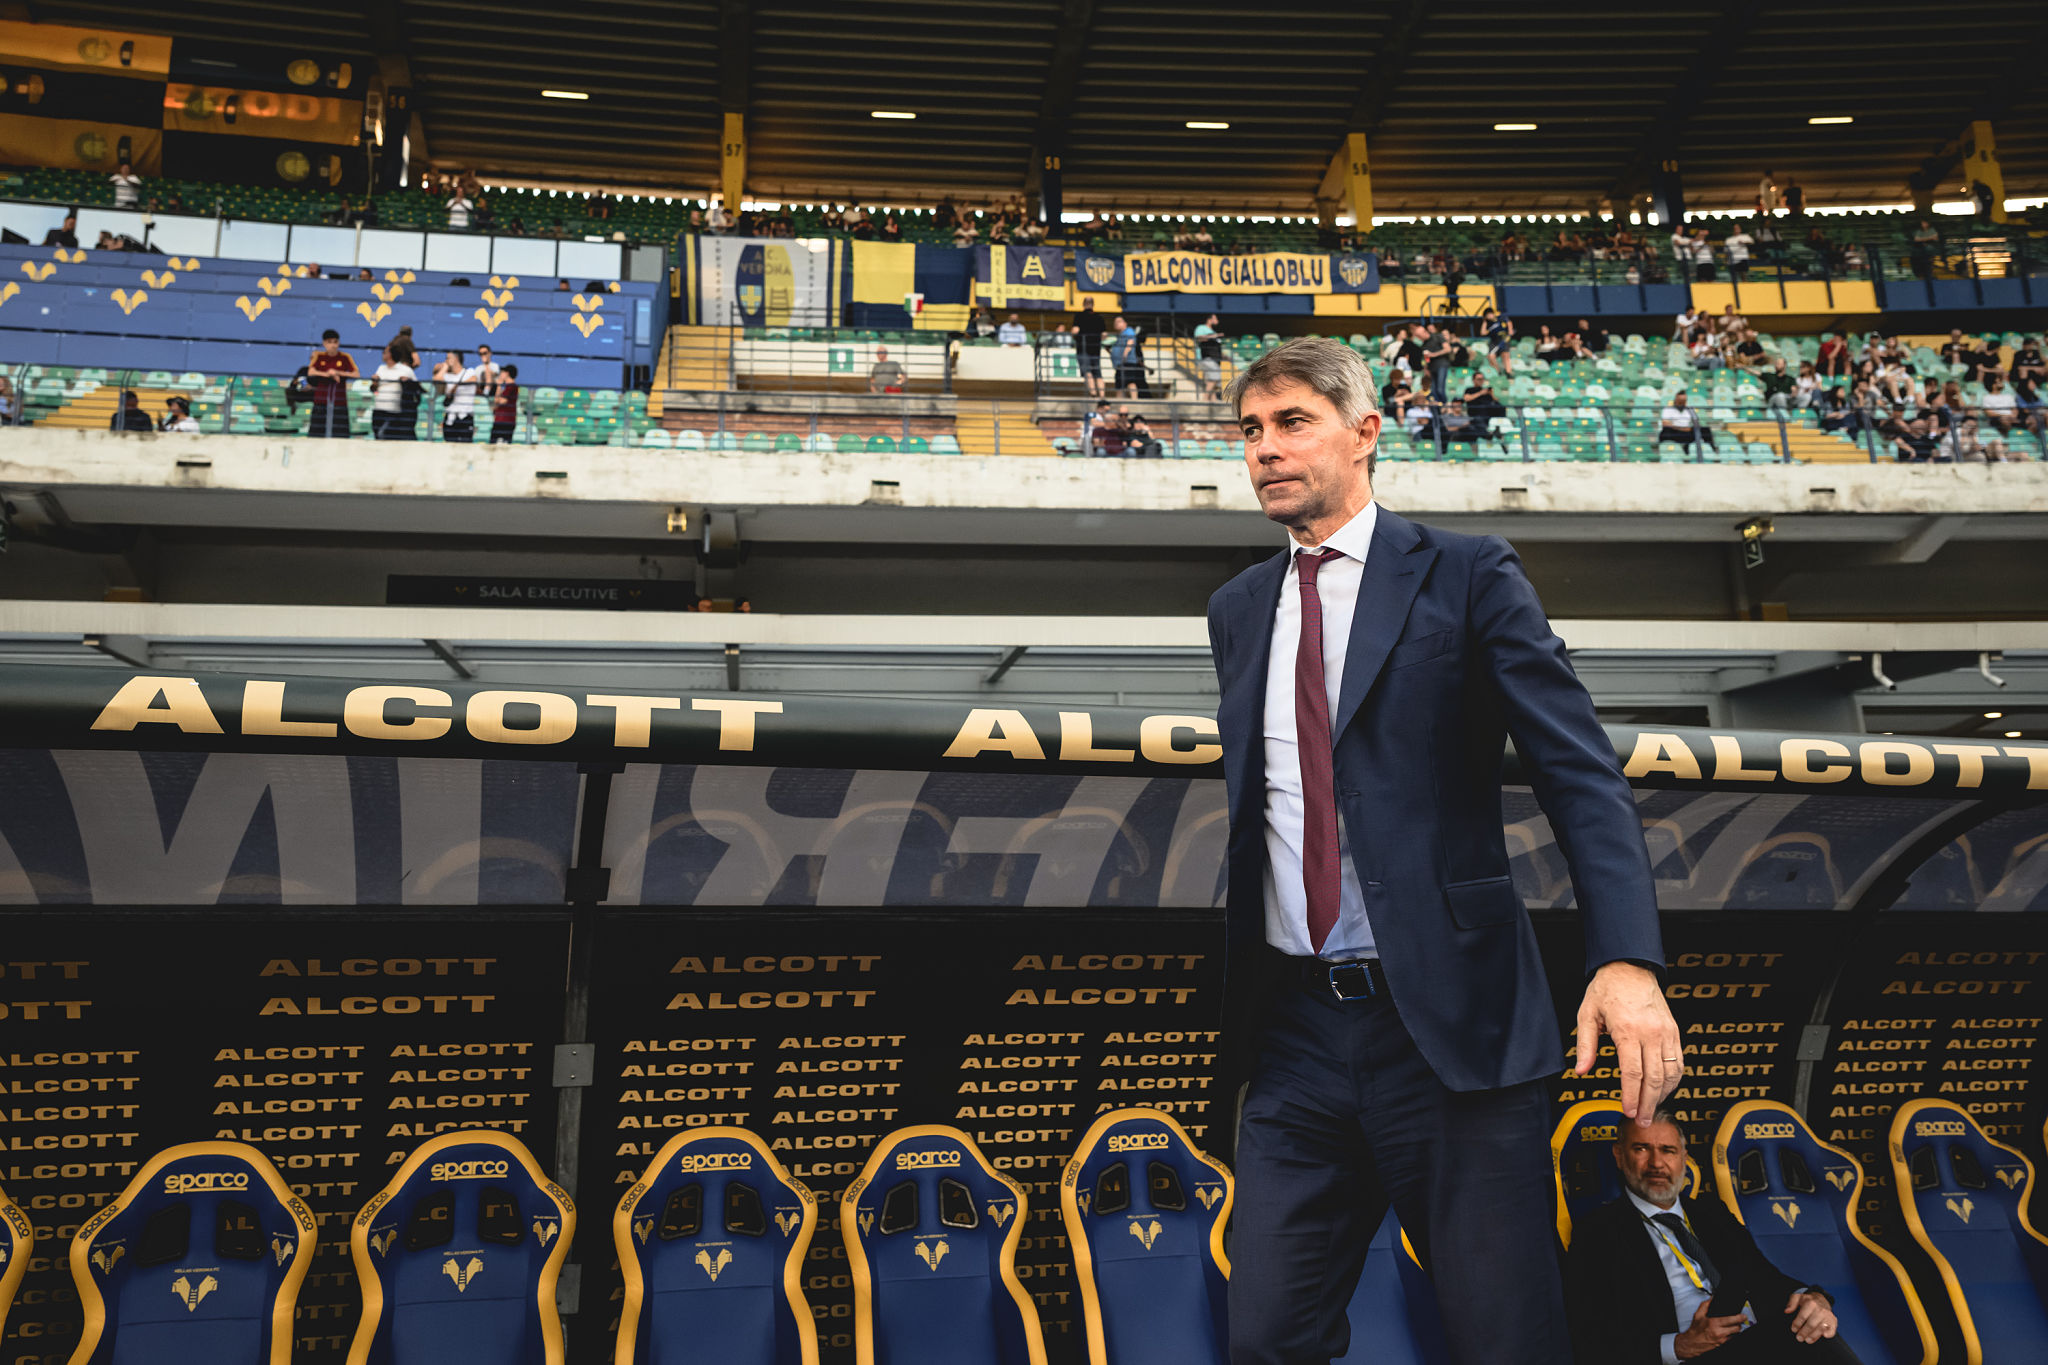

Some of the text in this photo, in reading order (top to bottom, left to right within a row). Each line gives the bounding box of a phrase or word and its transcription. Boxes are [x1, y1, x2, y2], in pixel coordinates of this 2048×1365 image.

[726, 143, 742, 157] 57
[740, 263, 792, 276] VERONA
[1131, 257, 1213, 287] BALCONI
[1220, 257, 1324, 286] GIALLOBLU
[479, 585, 619, 600] SALA EXECUTIVE
[90, 675, 783, 751] ALCOTT
[942, 708, 1224, 765] ALC
[1623, 733, 2048, 790] ALCOTT
[670, 956, 881, 973] ALCOTT
[1012, 955, 1205, 970] ALCOTT
[1666, 953, 1784, 968] COTT
[1896, 952, 2047, 965] ALCOTT
[260, 959, 496, 976] ALCOTT
[1665, 984, 1771, 999] COTT
[1882, 981, 2031, 994] ALCOTT
[666, 991, 876, 1009] ALCOTT
[1005, 989, 1196, 1005] ALCOTT
[259, 996, 495, 1015] ALCOTT
[1686, 1023, 1784, 1034] ALCOTT
[1843, 1019, 1936, 1030] ALCOTT
[1952, 1019, 2042, 1028] ALCOTT
[779, 1036, 906, 1048] ALCOTT
[963, 1033, 1084, 1045] ALCOTT
[1104, 1032, 1220, 1043] ALCOTT
[1946, 1038, 2036, 1049] ALCOTT
[390, 1043, 533, 1057] ALCOTT
[623, 1039, 756, 1052] ALCOTT
[1683, 1043, 1779, 1055] ALCOTT
[1838, 1040, 1931, 1051] ALCOTT
[214, 1046, 364, 1061] ALCOTT
[1101, 1054, 1216, 1066] ALCOTT
[621, 1063, 754, 1077] ALCOTT
[776, 1059, 903, 1073] ALCOTT
[960, 1056, 1080, 1069] ALCOTT
[1834, 1061, 1927, 1072] ALCOTT
[1942, 1059, 2032, 1070] ALCOTT
[214, 1072, 363, 1087] ALCOTT
[389, 1068, 531, 1083] ALCOTT
[774, 1084, 900, 1098] ALCOTT
[958, 1080, 1078, 1093] ALCOTT
[1098, 1077, 1213, 1090] ALCOTT
[1832, 1082, 1924, 1095] ALCOTT
[1939, 1080, 2028, 1092] ALCOTT
[619, 1087, 751, 1102] ALCOTT
[1674, 1086, 1771, 1099] ALCOTT
[213, 1098, 362, 1114] ALCOTT
[388, 1094, 530, 1109] ALCOTT
[1967, 1102, 2026, 1114] COTT
[772, 1109, 898, 1123] ALCOTT
[956, 1104, 1075, 1118] ALCOTT
[1829, 1105, 1892, 1118] ALCO
[617, 1112, 750, 1129] ALCOTT
[967, 1129, 1073, 1144] LCOTT
[1580, 1125, 1618, 1142] spar
[1744, 1123, 1795, 1140] sparco
[772, 1134, 881, 1150] ALCOT
[1108, 1133, 1169, 1152] sparco
[681, 1153, 752, 1173] sparco
[896, 1150, 961, 1170] sparco
[993, 1155, 1071, 1169] COTT
[431, 1160, 508, 1181] sparco
[164, 1172, 249, 1193] sparco
[545, 1183, 574, 1213] sparco
[620, 1182, 646, 1213] sparco
[287, 1197, 314, 1232] sparco
[357, 1191, 388, 1227] sparco
[2, 1204, 30, 1240] sparco
[79, 1204, 119, 1242] sparco
